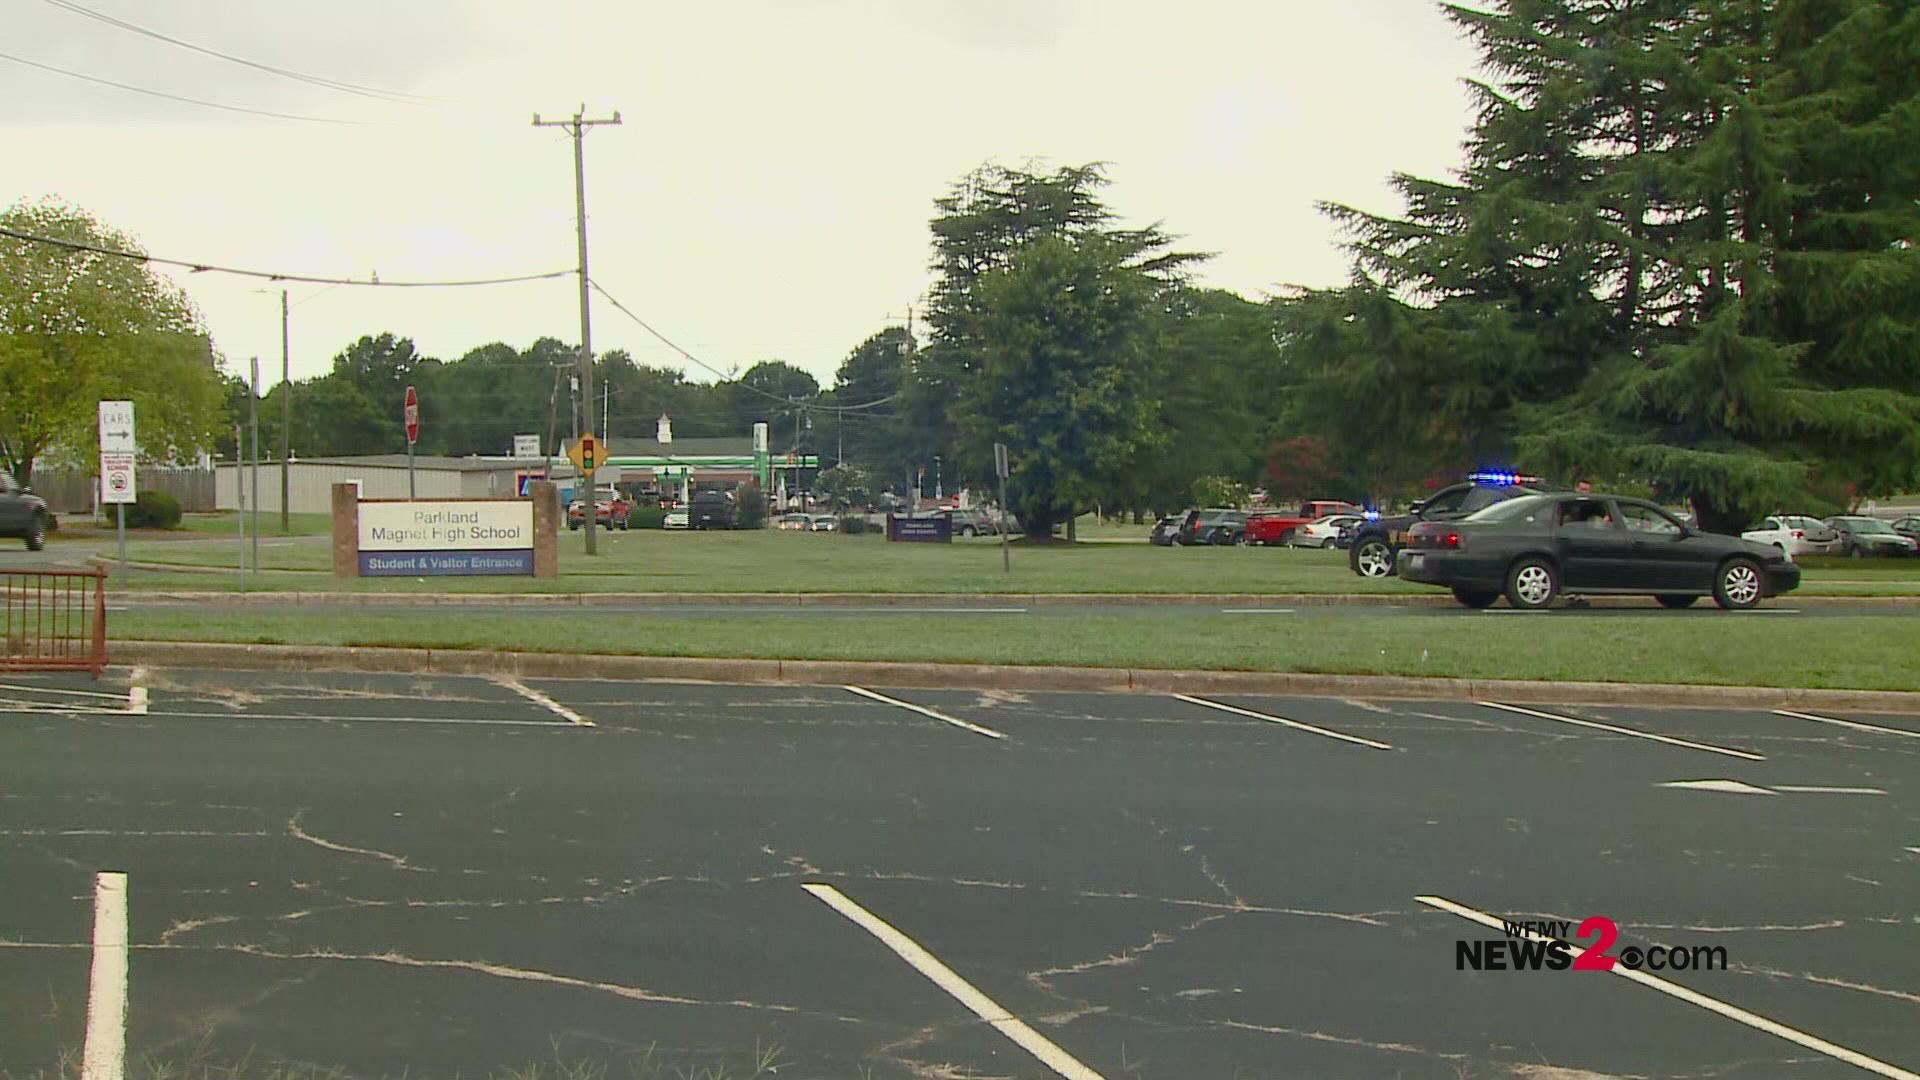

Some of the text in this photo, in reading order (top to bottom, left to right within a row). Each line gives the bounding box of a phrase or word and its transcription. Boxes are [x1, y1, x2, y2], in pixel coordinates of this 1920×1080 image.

[104, 413, 130, 424] CARS
[414, 511, 479, 524] Parkland
[371, 526, 521, 543] Magnet High School
[368, 557, 523, 570] Student & Visitor Entrance
